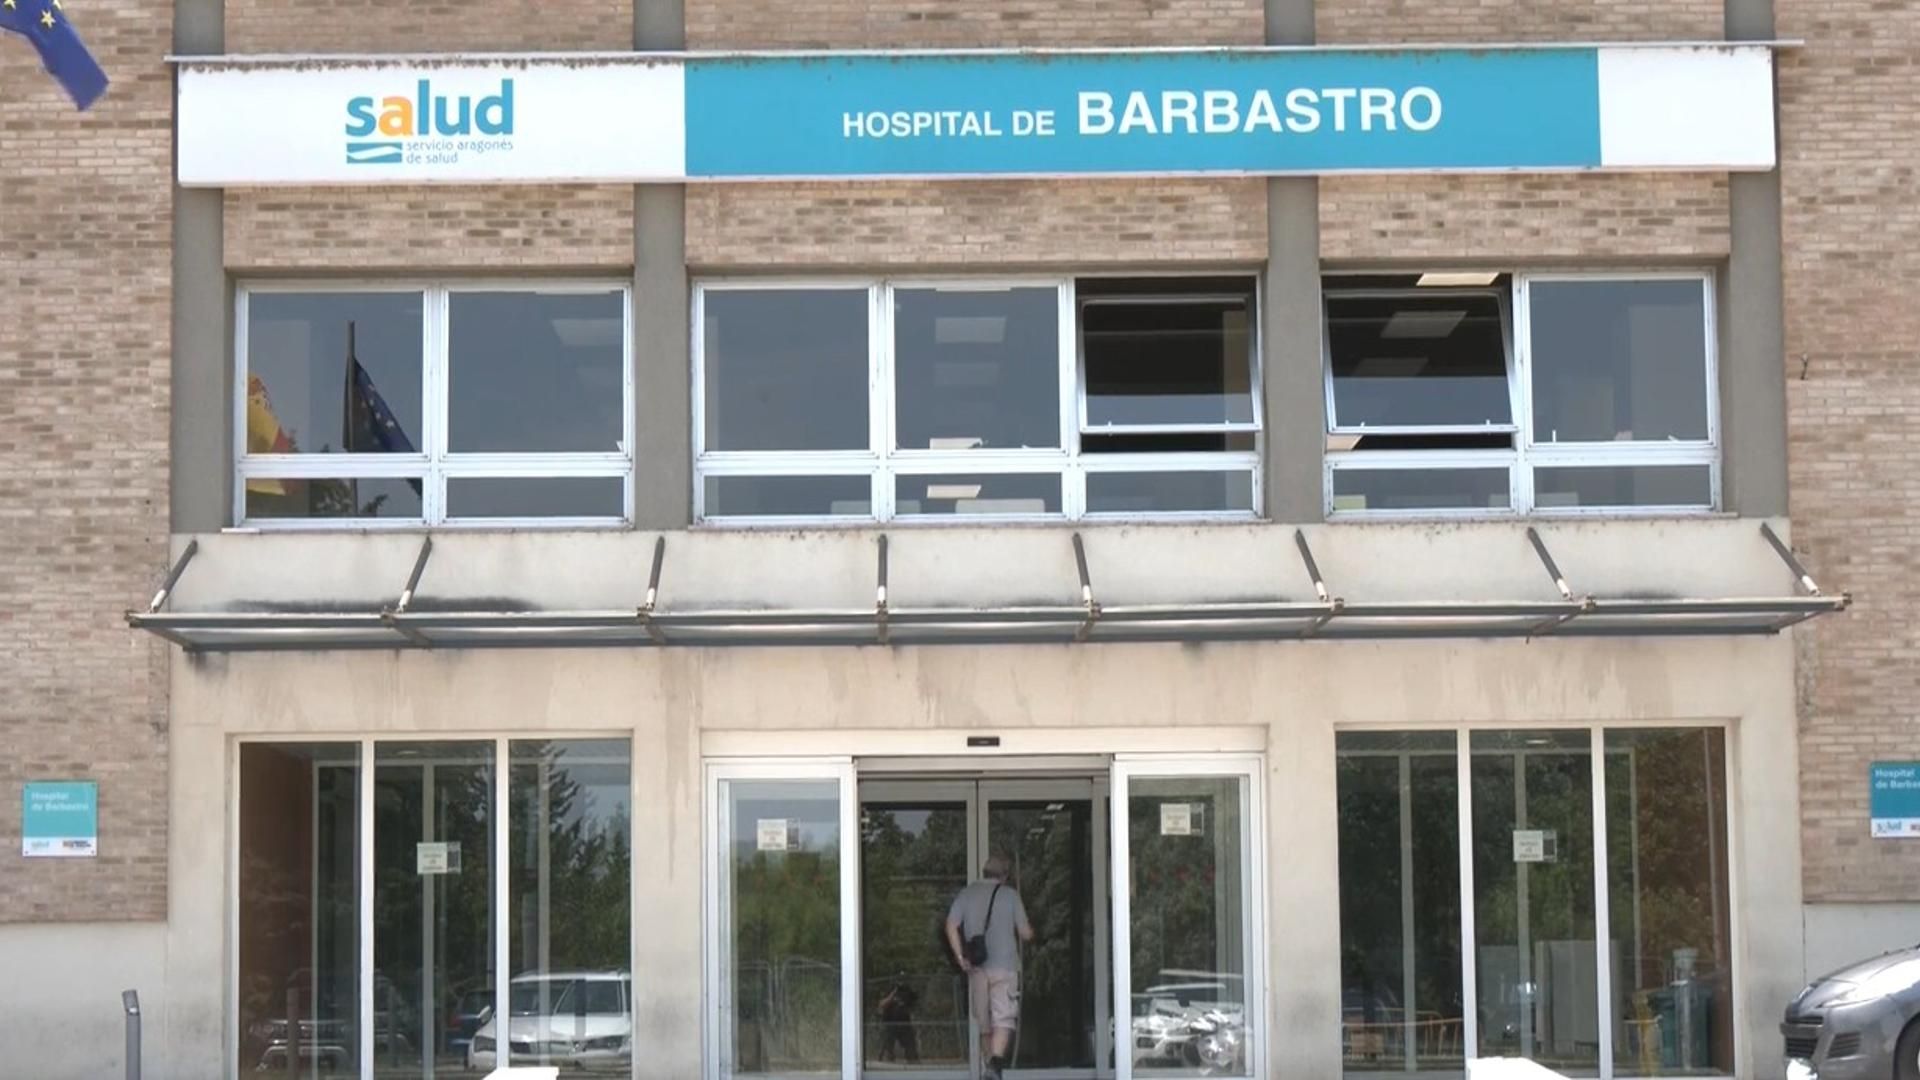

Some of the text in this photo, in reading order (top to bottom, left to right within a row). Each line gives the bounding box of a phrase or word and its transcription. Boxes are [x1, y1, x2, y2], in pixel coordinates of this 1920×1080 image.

[345, 78, 514, 138] salud
[842, 86, 1443, 138] HOSPITAL DE BARBASTRO
[406, 139, 514, 154] servicio aragonés
[406, 152, 459, 165] de salud
[1874, 768, 1916, 779] Hospital
